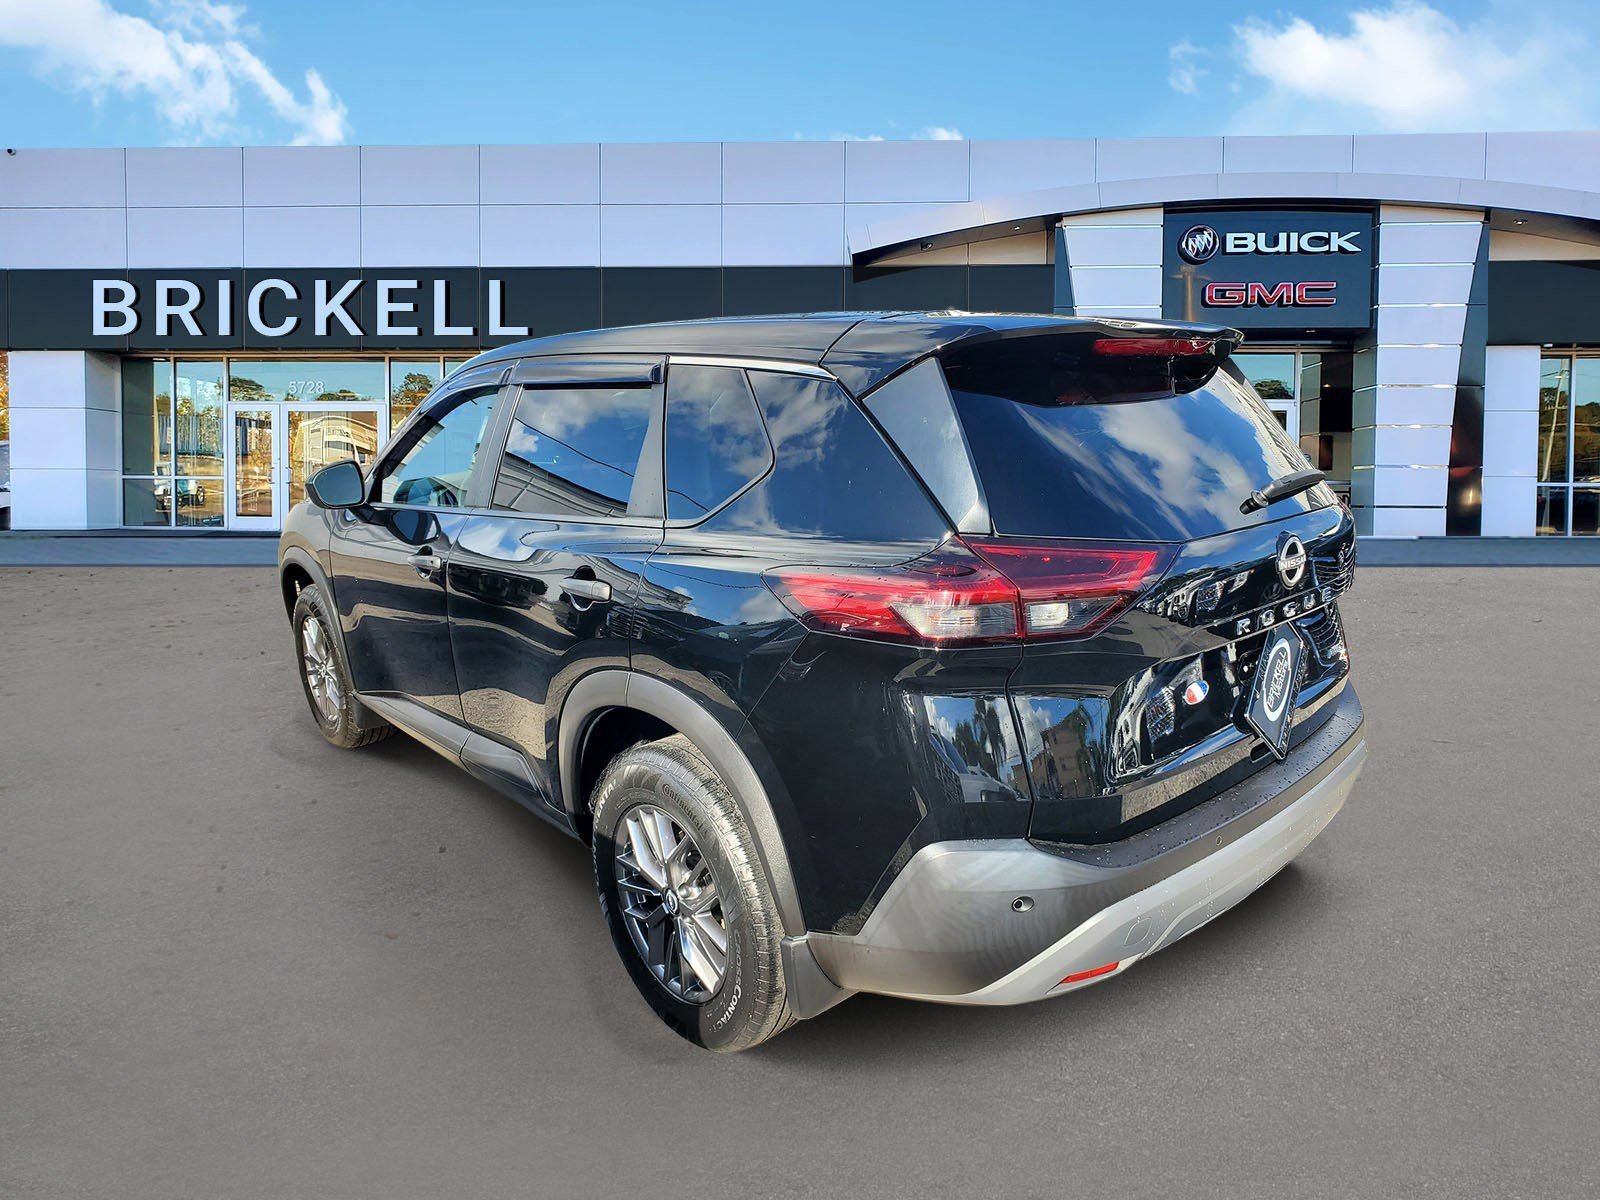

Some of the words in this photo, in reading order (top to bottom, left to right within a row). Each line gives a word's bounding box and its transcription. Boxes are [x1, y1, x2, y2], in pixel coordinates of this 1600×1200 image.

[1225, 231, 1362, 253] BUICK
[1205, 281, 1337, 305] GMC
[92, 278, 532, 337] BRICKELL
[288, 380, 325, 395] 5728
[1279, 554, 1307, 571] NISS
[1236, 586, 1332, 636] ROGUE
